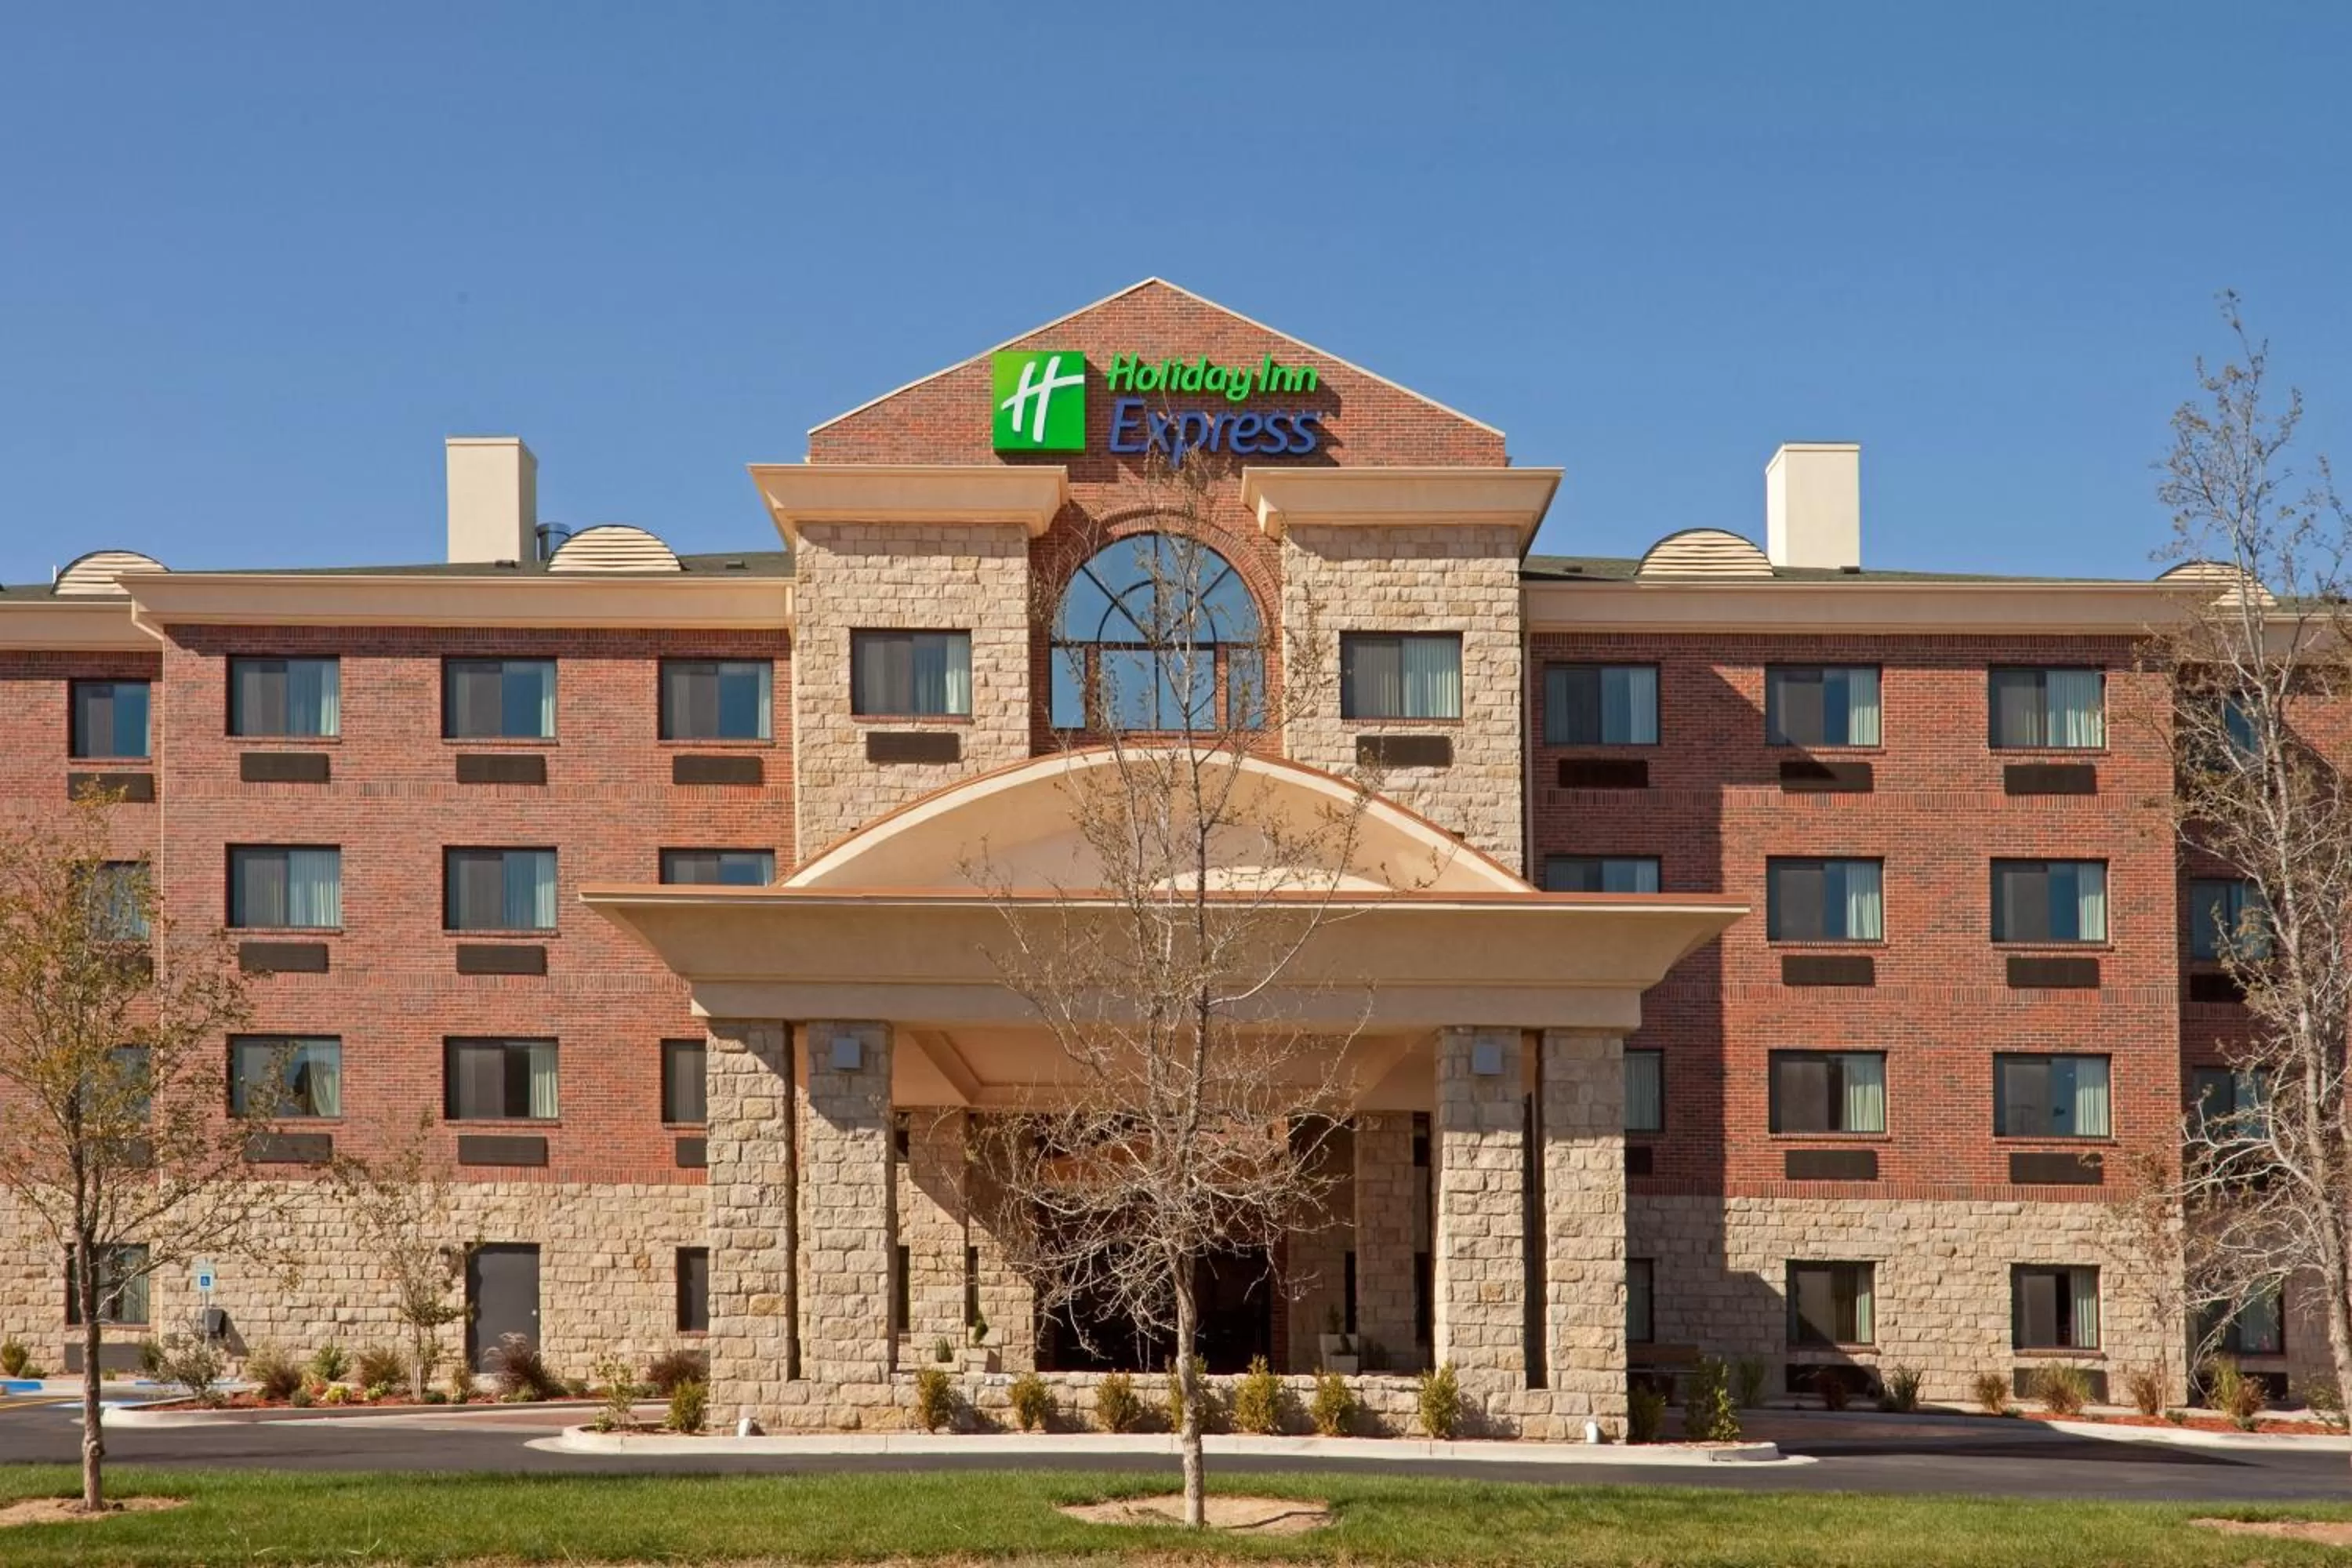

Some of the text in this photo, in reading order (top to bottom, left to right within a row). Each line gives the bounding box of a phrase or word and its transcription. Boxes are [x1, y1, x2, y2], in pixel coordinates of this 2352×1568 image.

[1106, 350, 1318, 401] Holiday Inn
[1109, 397, 1319, 468] Express
